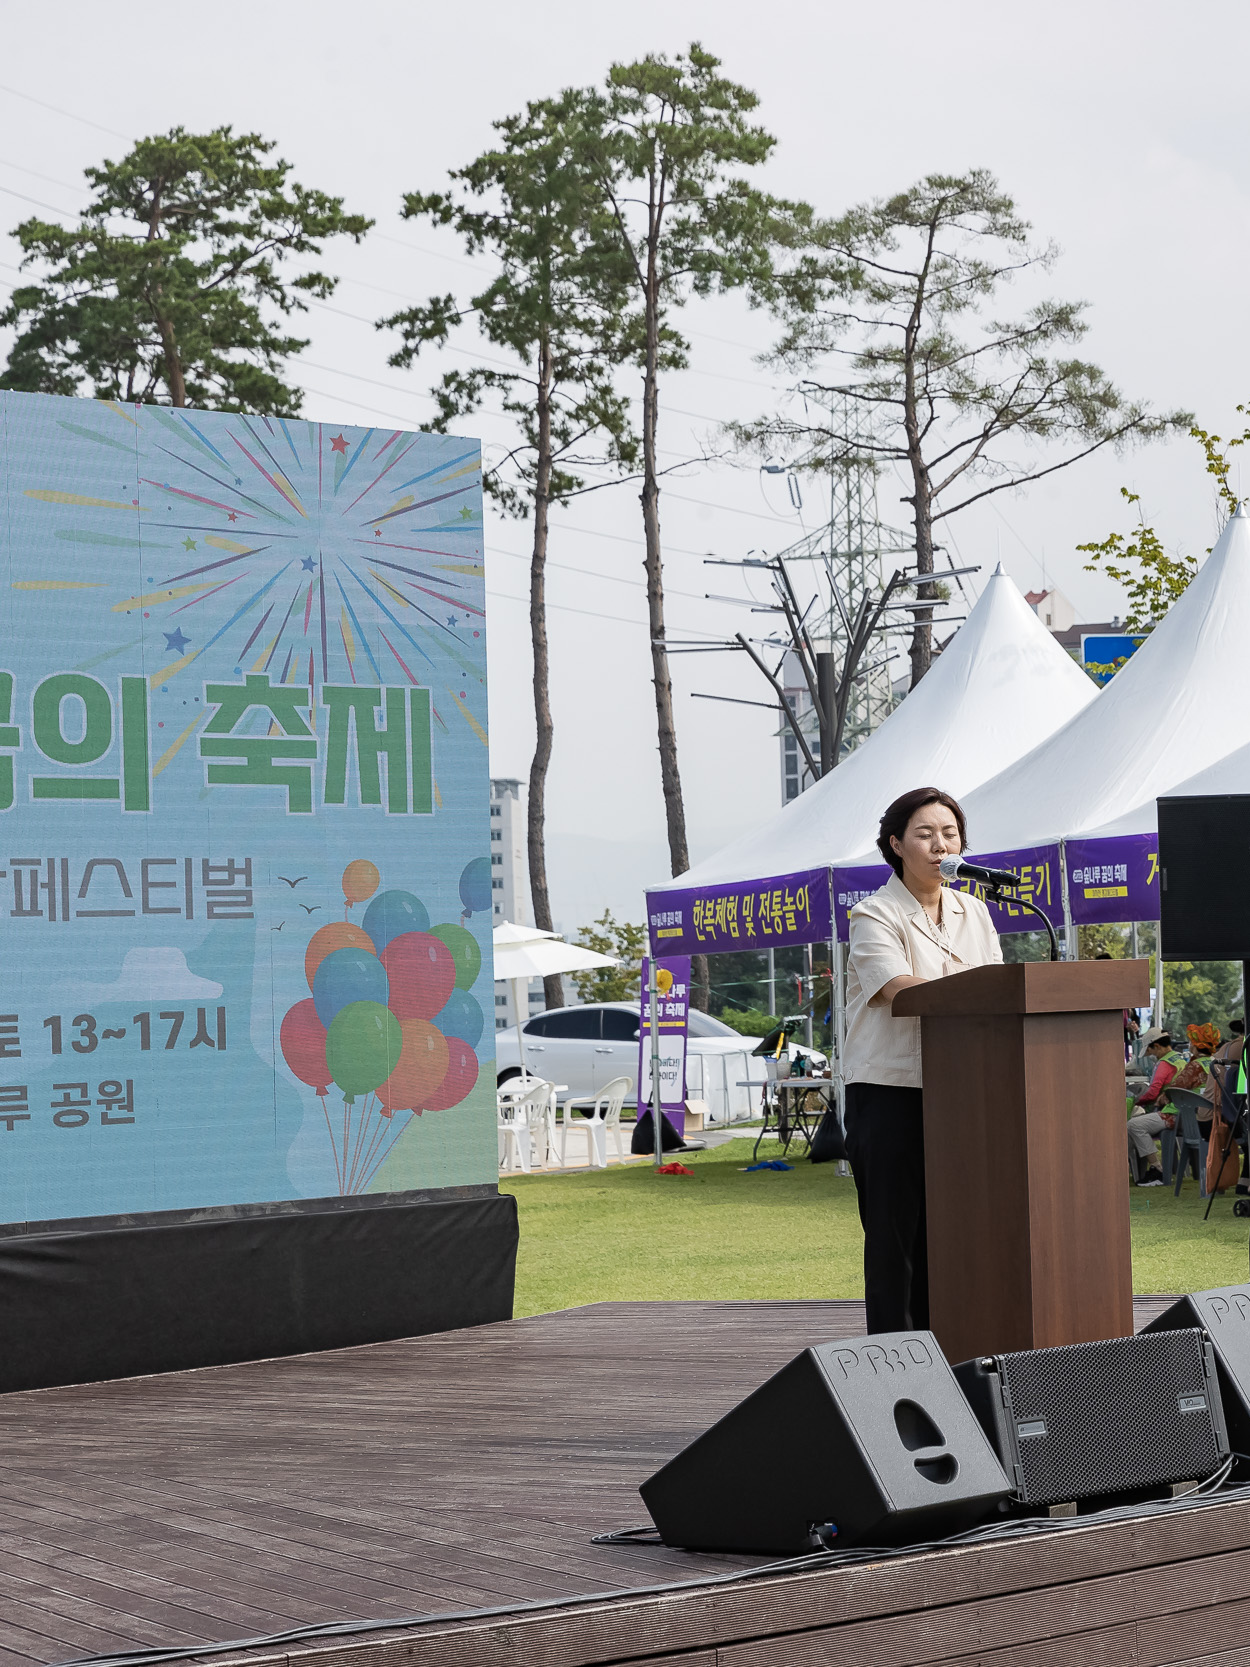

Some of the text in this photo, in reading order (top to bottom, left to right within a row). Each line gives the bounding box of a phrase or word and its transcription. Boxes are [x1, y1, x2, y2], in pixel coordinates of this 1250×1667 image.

[0, 668, 435, 816] 의 축제
[0, 857, 254, 922] 페스티벌
[693, 884, 810, 941] 한복체험 및 전통놀이
[43, 1006, 226, 1054] 13~17시
[665, 1002, 686, 1017] 축제
[51, 1079, 135, 1128] 공원
